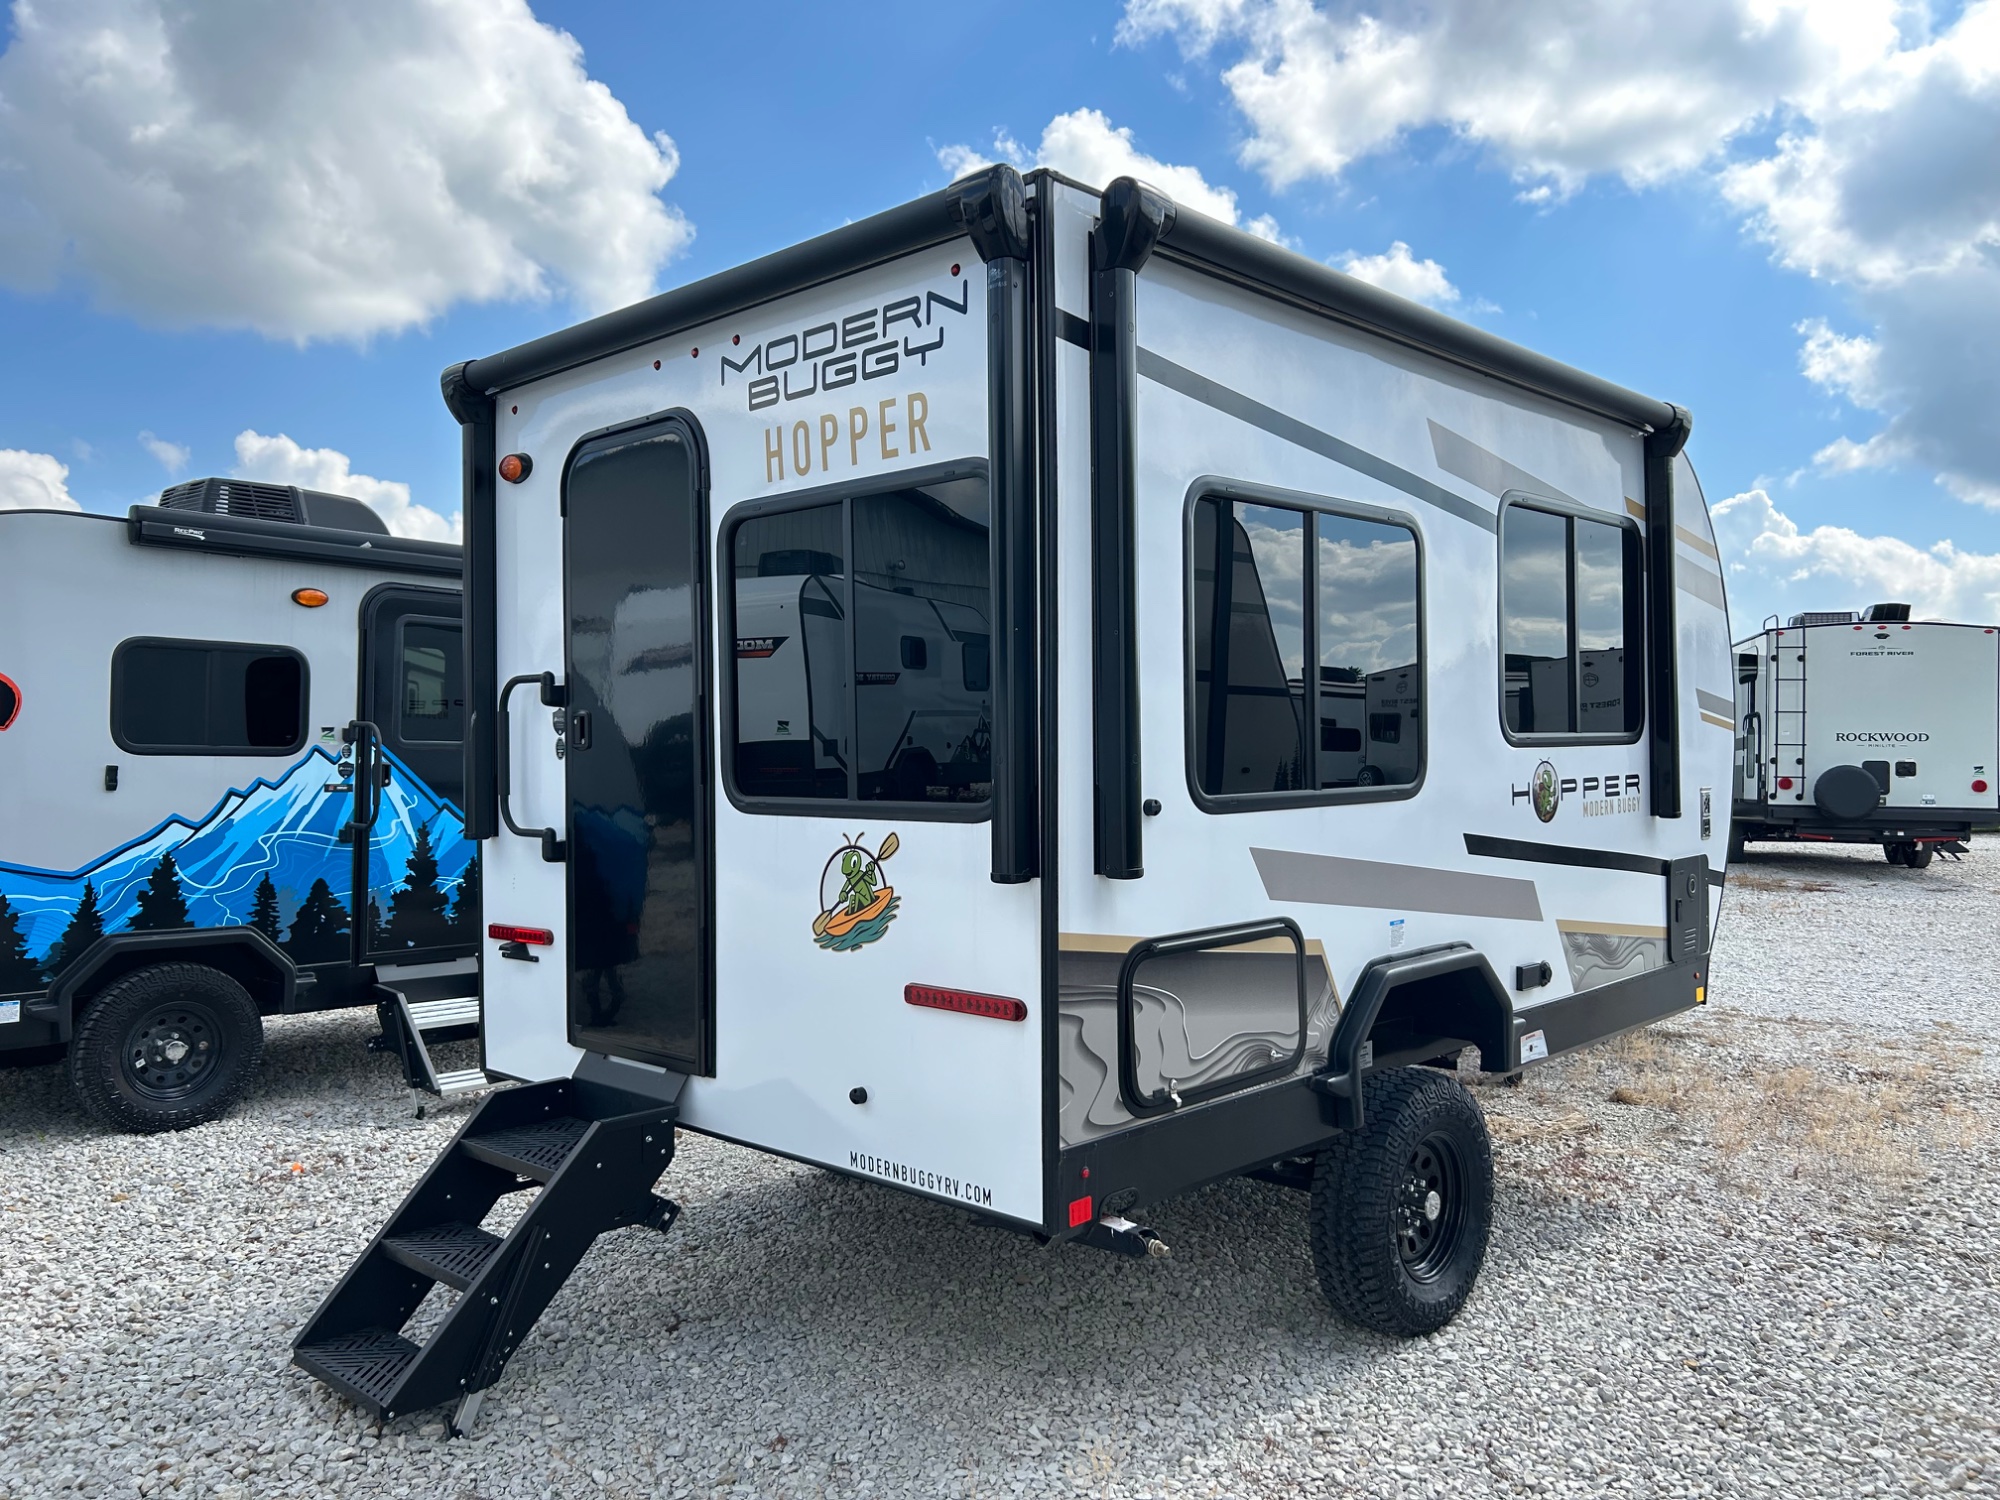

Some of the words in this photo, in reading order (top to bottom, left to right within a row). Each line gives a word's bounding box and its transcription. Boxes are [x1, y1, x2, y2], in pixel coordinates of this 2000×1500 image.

[721, 279, 968, 386] MODERN
[749, 326, 944, 411] BUGGY
[765, 392, 931, 483] HOPPER
[1835, 732, 1930, 742] ROCKWOOD
[1583, 799, 1614, 818] MODERN
[1617, 796, 1641, 813] BUGGY
[850, 1150, 992, 1207] MODERNBUGGYRV.COM
